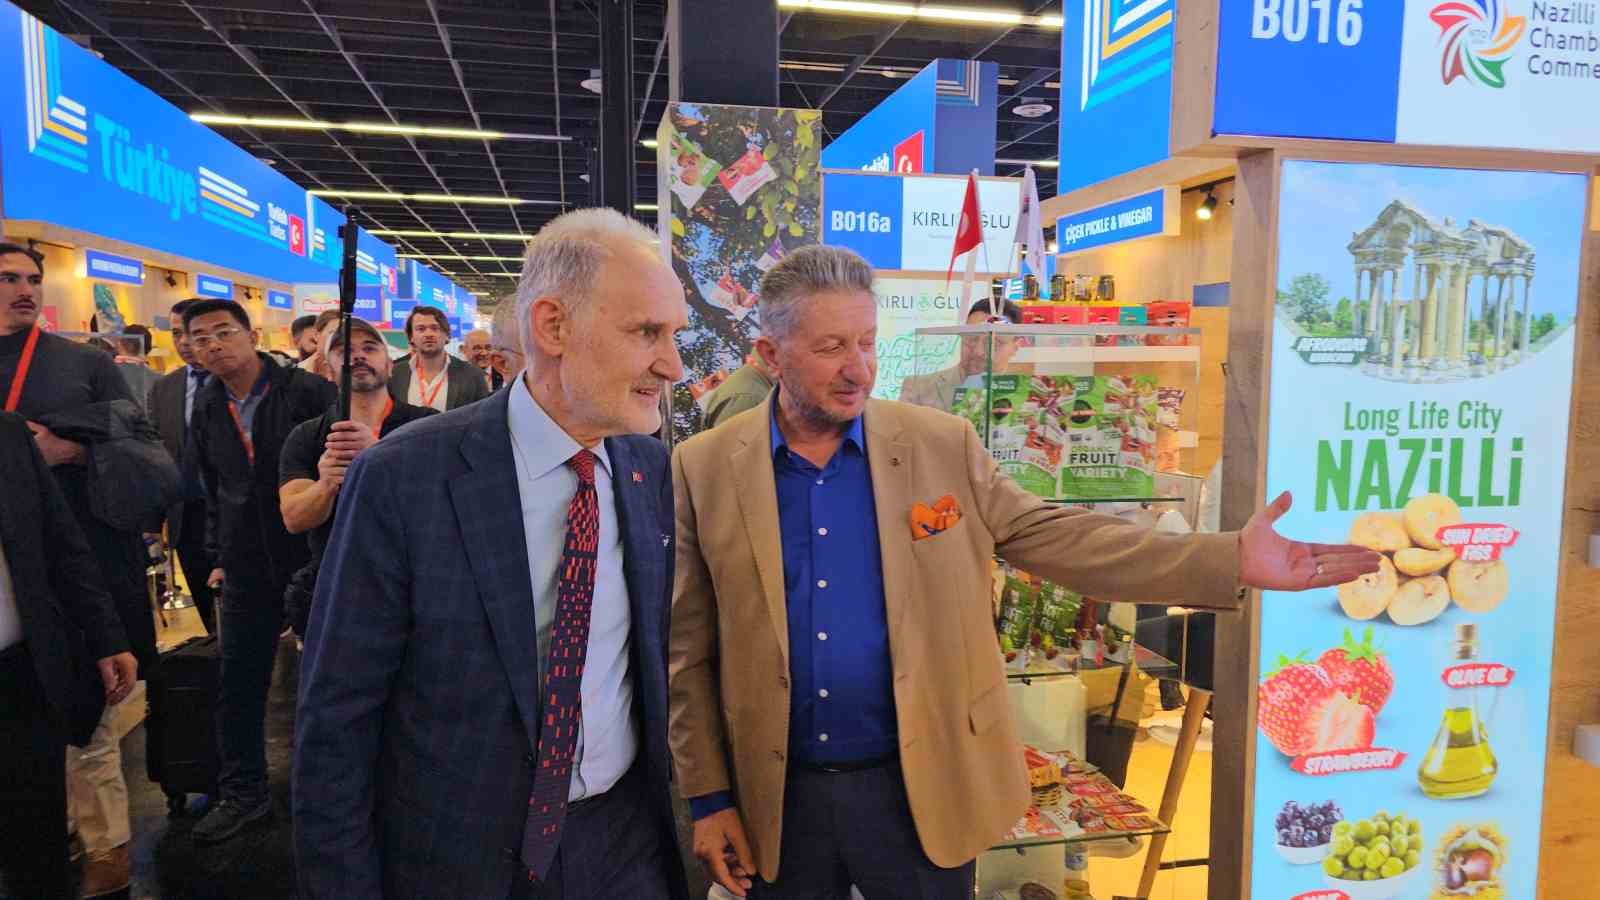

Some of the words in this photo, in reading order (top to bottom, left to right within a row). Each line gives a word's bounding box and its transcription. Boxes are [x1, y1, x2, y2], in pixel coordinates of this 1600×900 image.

[1251, 0, 1364, 46] B016
[1532, 1, 1597, 24] Nazilli
[94, 113, 197, 222] Türkiye
[831, 210, 891, 232] B016a
[1085, 216, 1110, 237] PICKLE
[1110, 215, 1117, 231] &
[1118, 206, 1153, 229] VINEGAR
[1344, 401, 1400, 436] Long
[1408, 400, 1449, 430] Life
[1458, 400, 1503, 434] City
[1070, 453, 1116, 465] FRUIT
[1070, 466, 1128, 479] VARIETY
[1448, 668, 1487, 686] OLIVE
[1487, 667, 1509, 684] OIL
[1304, 751, 1395, 775] STRAWBERRY
